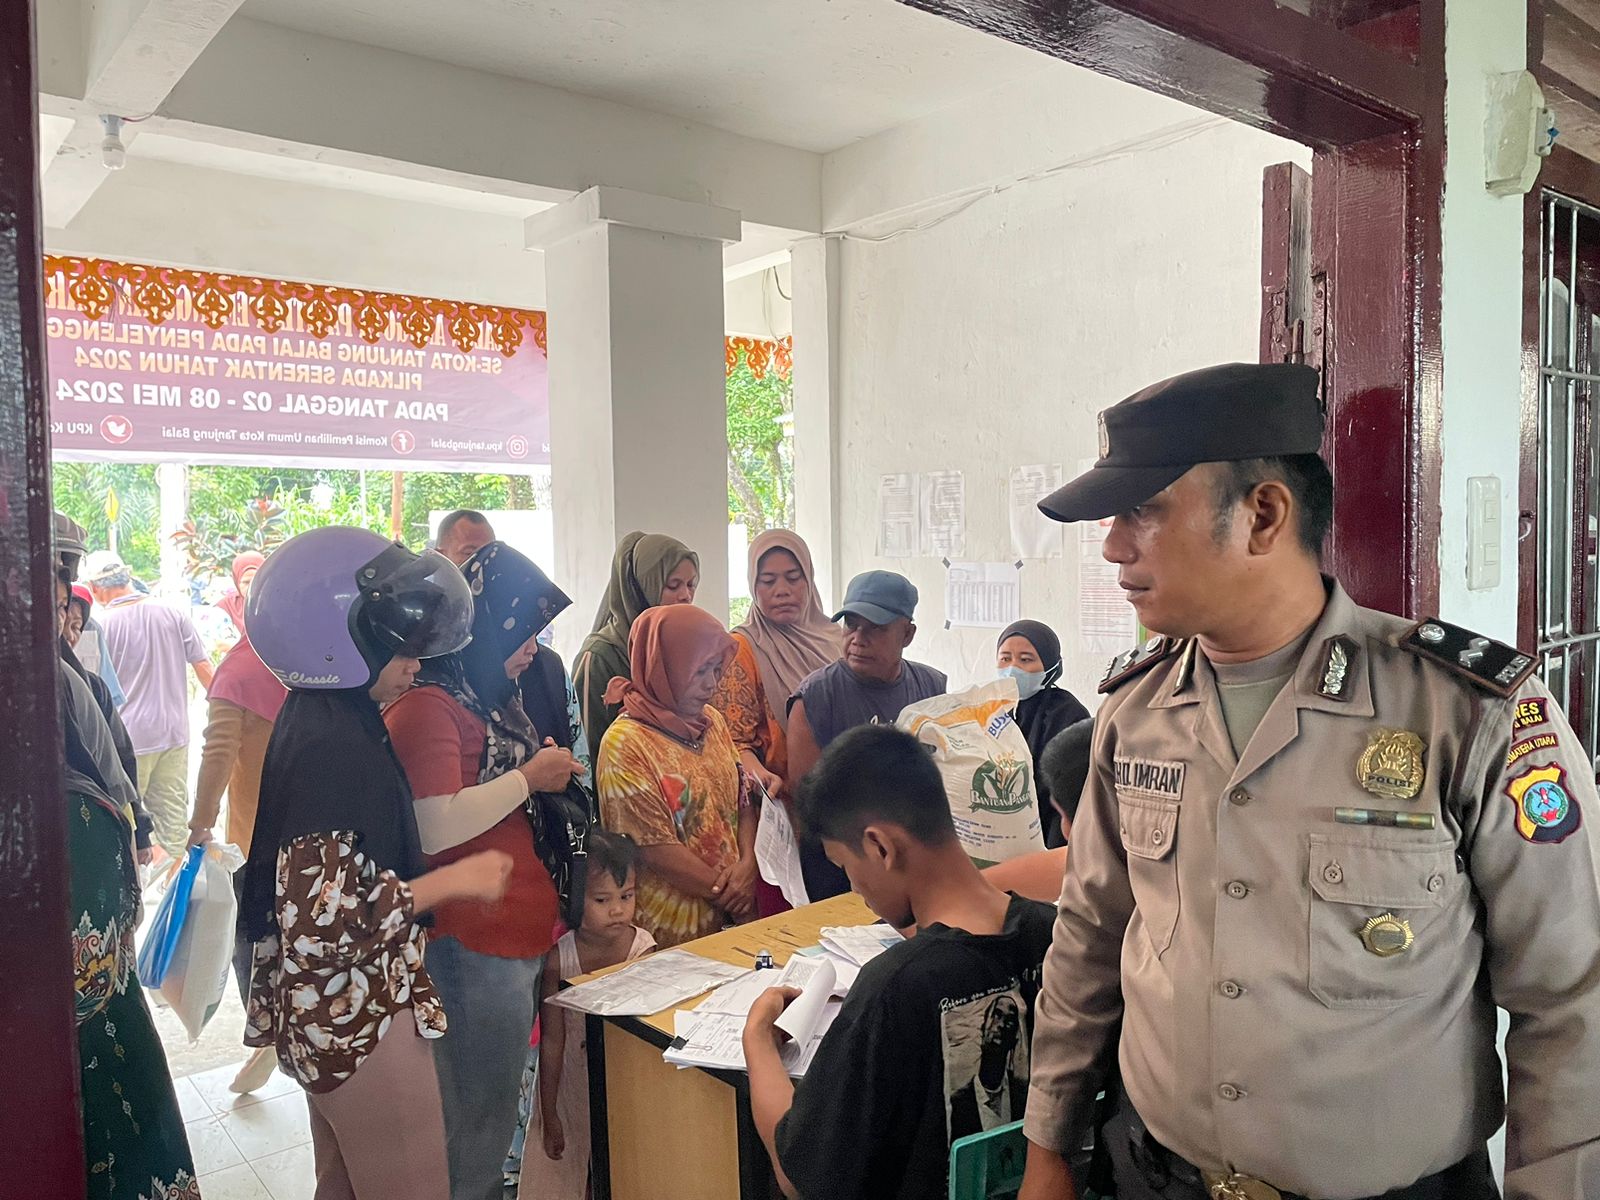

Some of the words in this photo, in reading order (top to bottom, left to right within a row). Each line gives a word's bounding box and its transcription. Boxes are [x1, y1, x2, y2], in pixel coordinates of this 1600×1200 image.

[288, 671, 341, 684] Classic
[1534, 735, 1556, 748] UTARA
[1134, 763, 1181, 793] IMRAN
